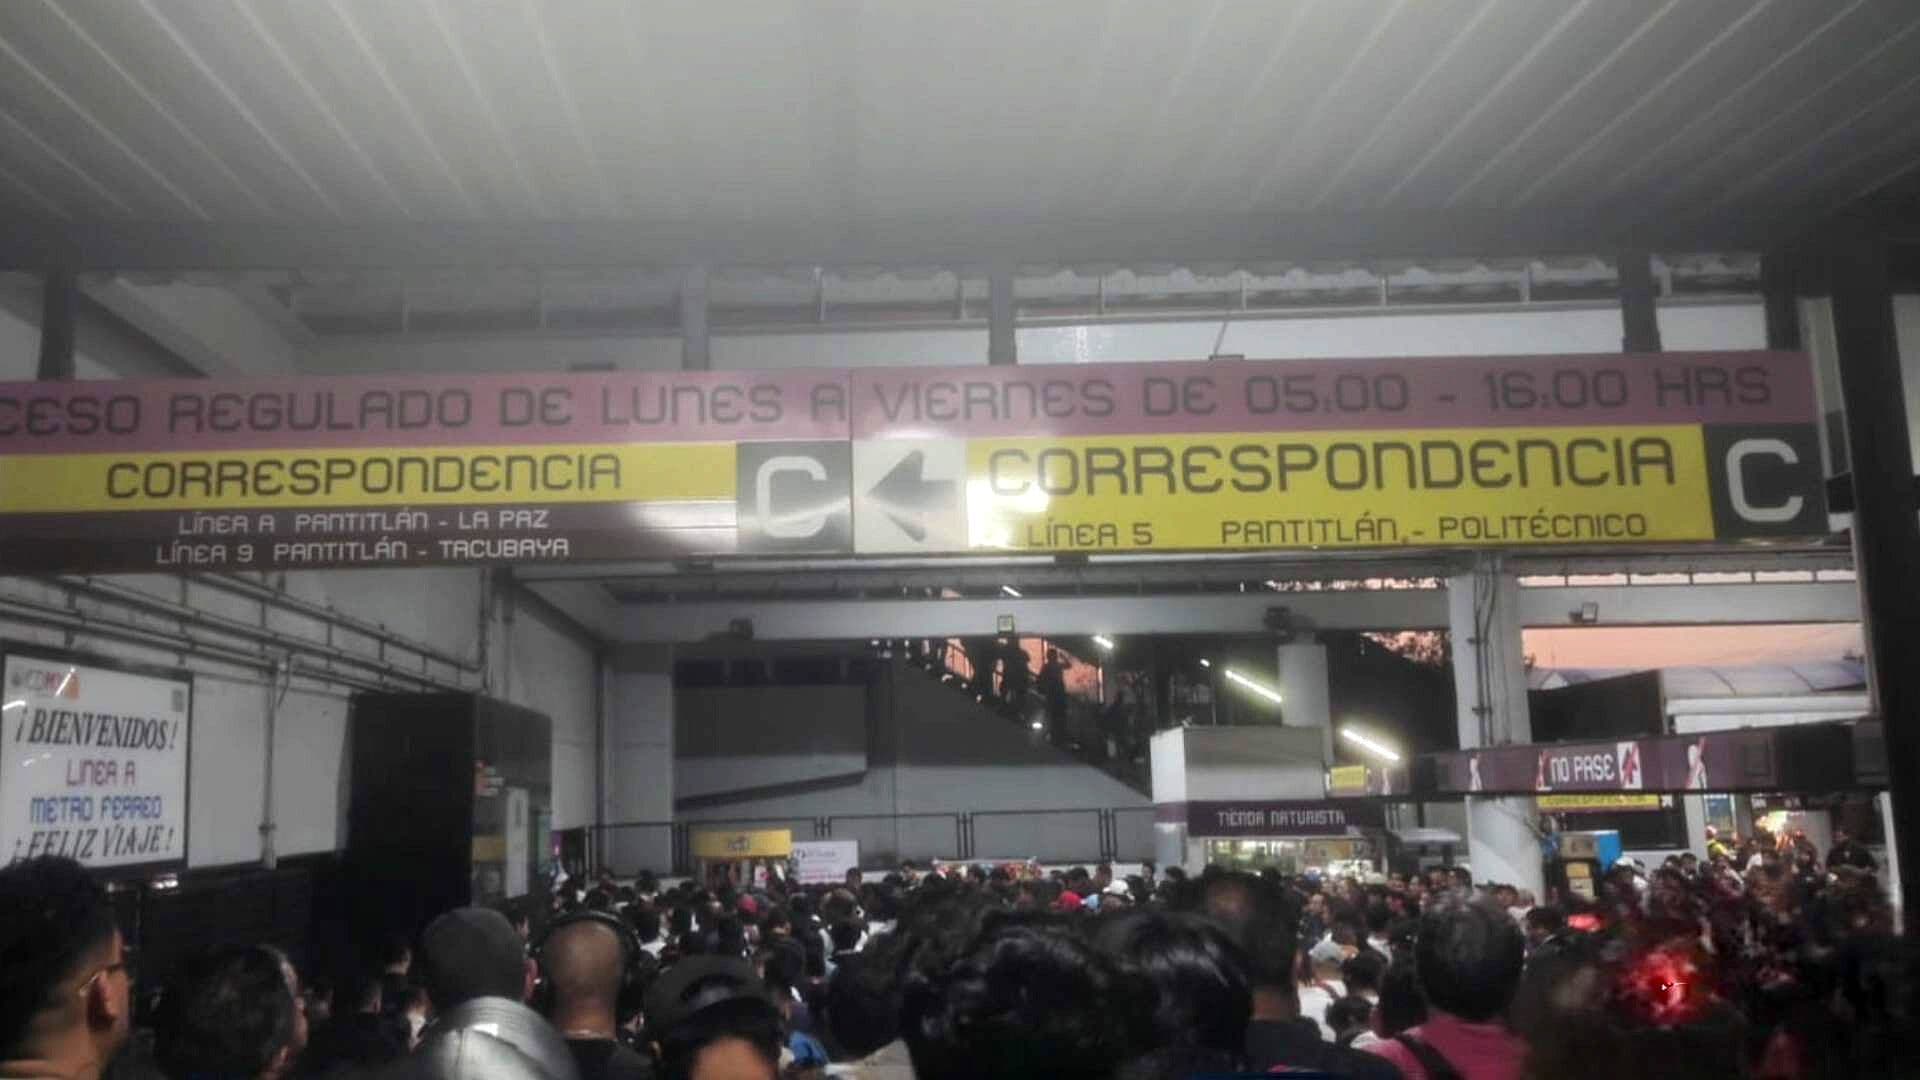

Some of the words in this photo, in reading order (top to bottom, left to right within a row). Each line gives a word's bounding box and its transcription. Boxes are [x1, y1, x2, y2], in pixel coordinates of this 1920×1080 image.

[168, 388, 472, 433] REGULADO
[501, 386, 572, 428] DE
[602, 383, 783, 426] LUNES
[809, 382, 847, 422] A
[874, 379, 1113, 422] VIERNES
[1142, 375, 1216, 417] DE
[1650, 366, 1771, 409] HRS
[106, 453, 622, 499] CORRESPONDENCIA
[989, 436, 1675, 496] CORRESPONDENCIA
[1726, 438, 1803, 522] C
[756, 455, 827, 538] C
[178, 511, 249, 535] LÍNEA
[259, 513, 275, 533] A
[296, 507, 428, 532] PANTITLÁN
[458, 511, 489, 529] LA
[500, 509, 549, 529] PAZ
[1027, 516, 1117, 546] LÍNEA
[1132, 521, 1153, 545] 5
[1221, 511, 1397, 544] PANTITLÁN
[1439, 509, 1647, 539] POLITÉCNICO
[156, 540, 226, 564] LÍNEA
[237, 544, 253, 562] 9
[273, 536, 407, 561] PANTITLÁN
[438, 538, 569, 559] TACUBAYA
[125, 761, 135, 785] A
[1551, 757, 1569, 784] NO
[1573, 754, 1615, 783] PASE
[30, 796, 94, 824] METRO
[101, 795, 162, 820] FERREO
[1217, 809, 1264, 826] TIENDA
[1271, 809, 1345, 826] NATURISTA
